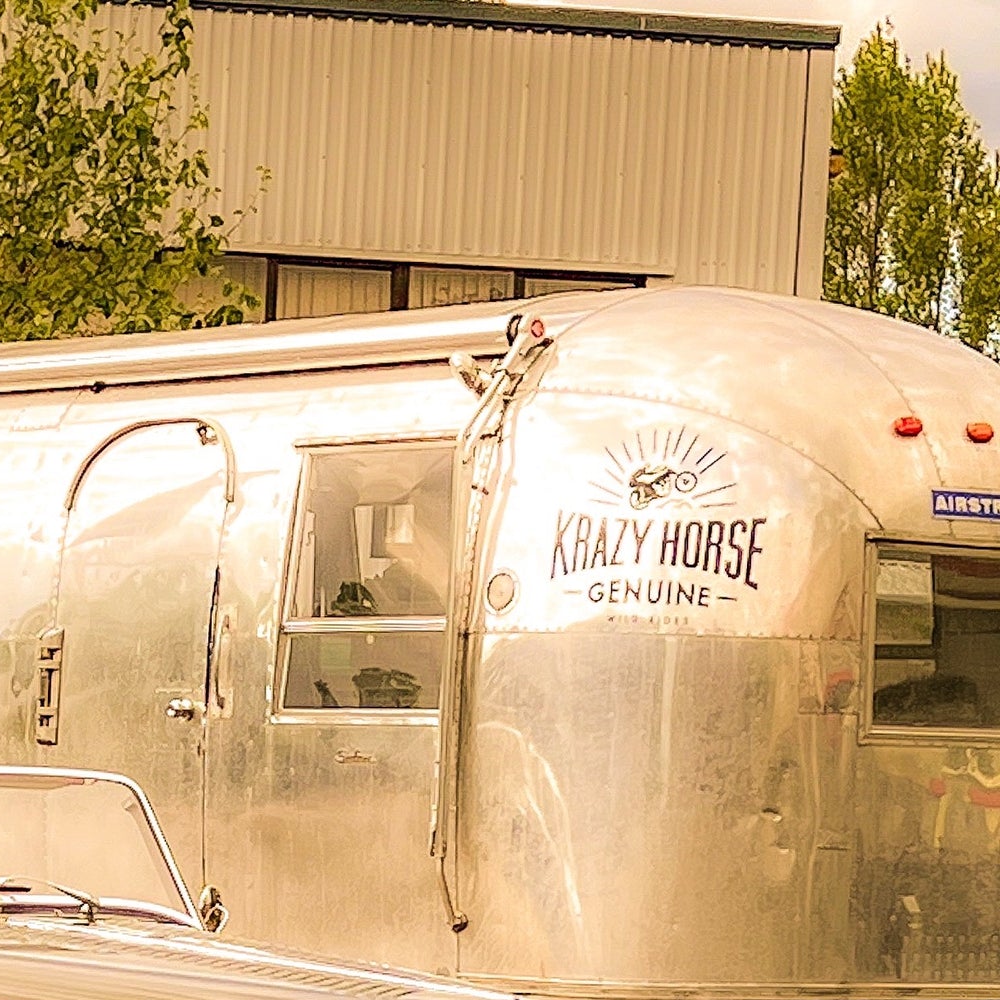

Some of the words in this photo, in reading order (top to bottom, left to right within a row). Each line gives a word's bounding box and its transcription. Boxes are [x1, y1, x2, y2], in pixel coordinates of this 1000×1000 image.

[551, 509, 653, 579] KRAZY
[660, 517, 767, 590] HORSE
[588, 578, 711, 607] GENUINE
